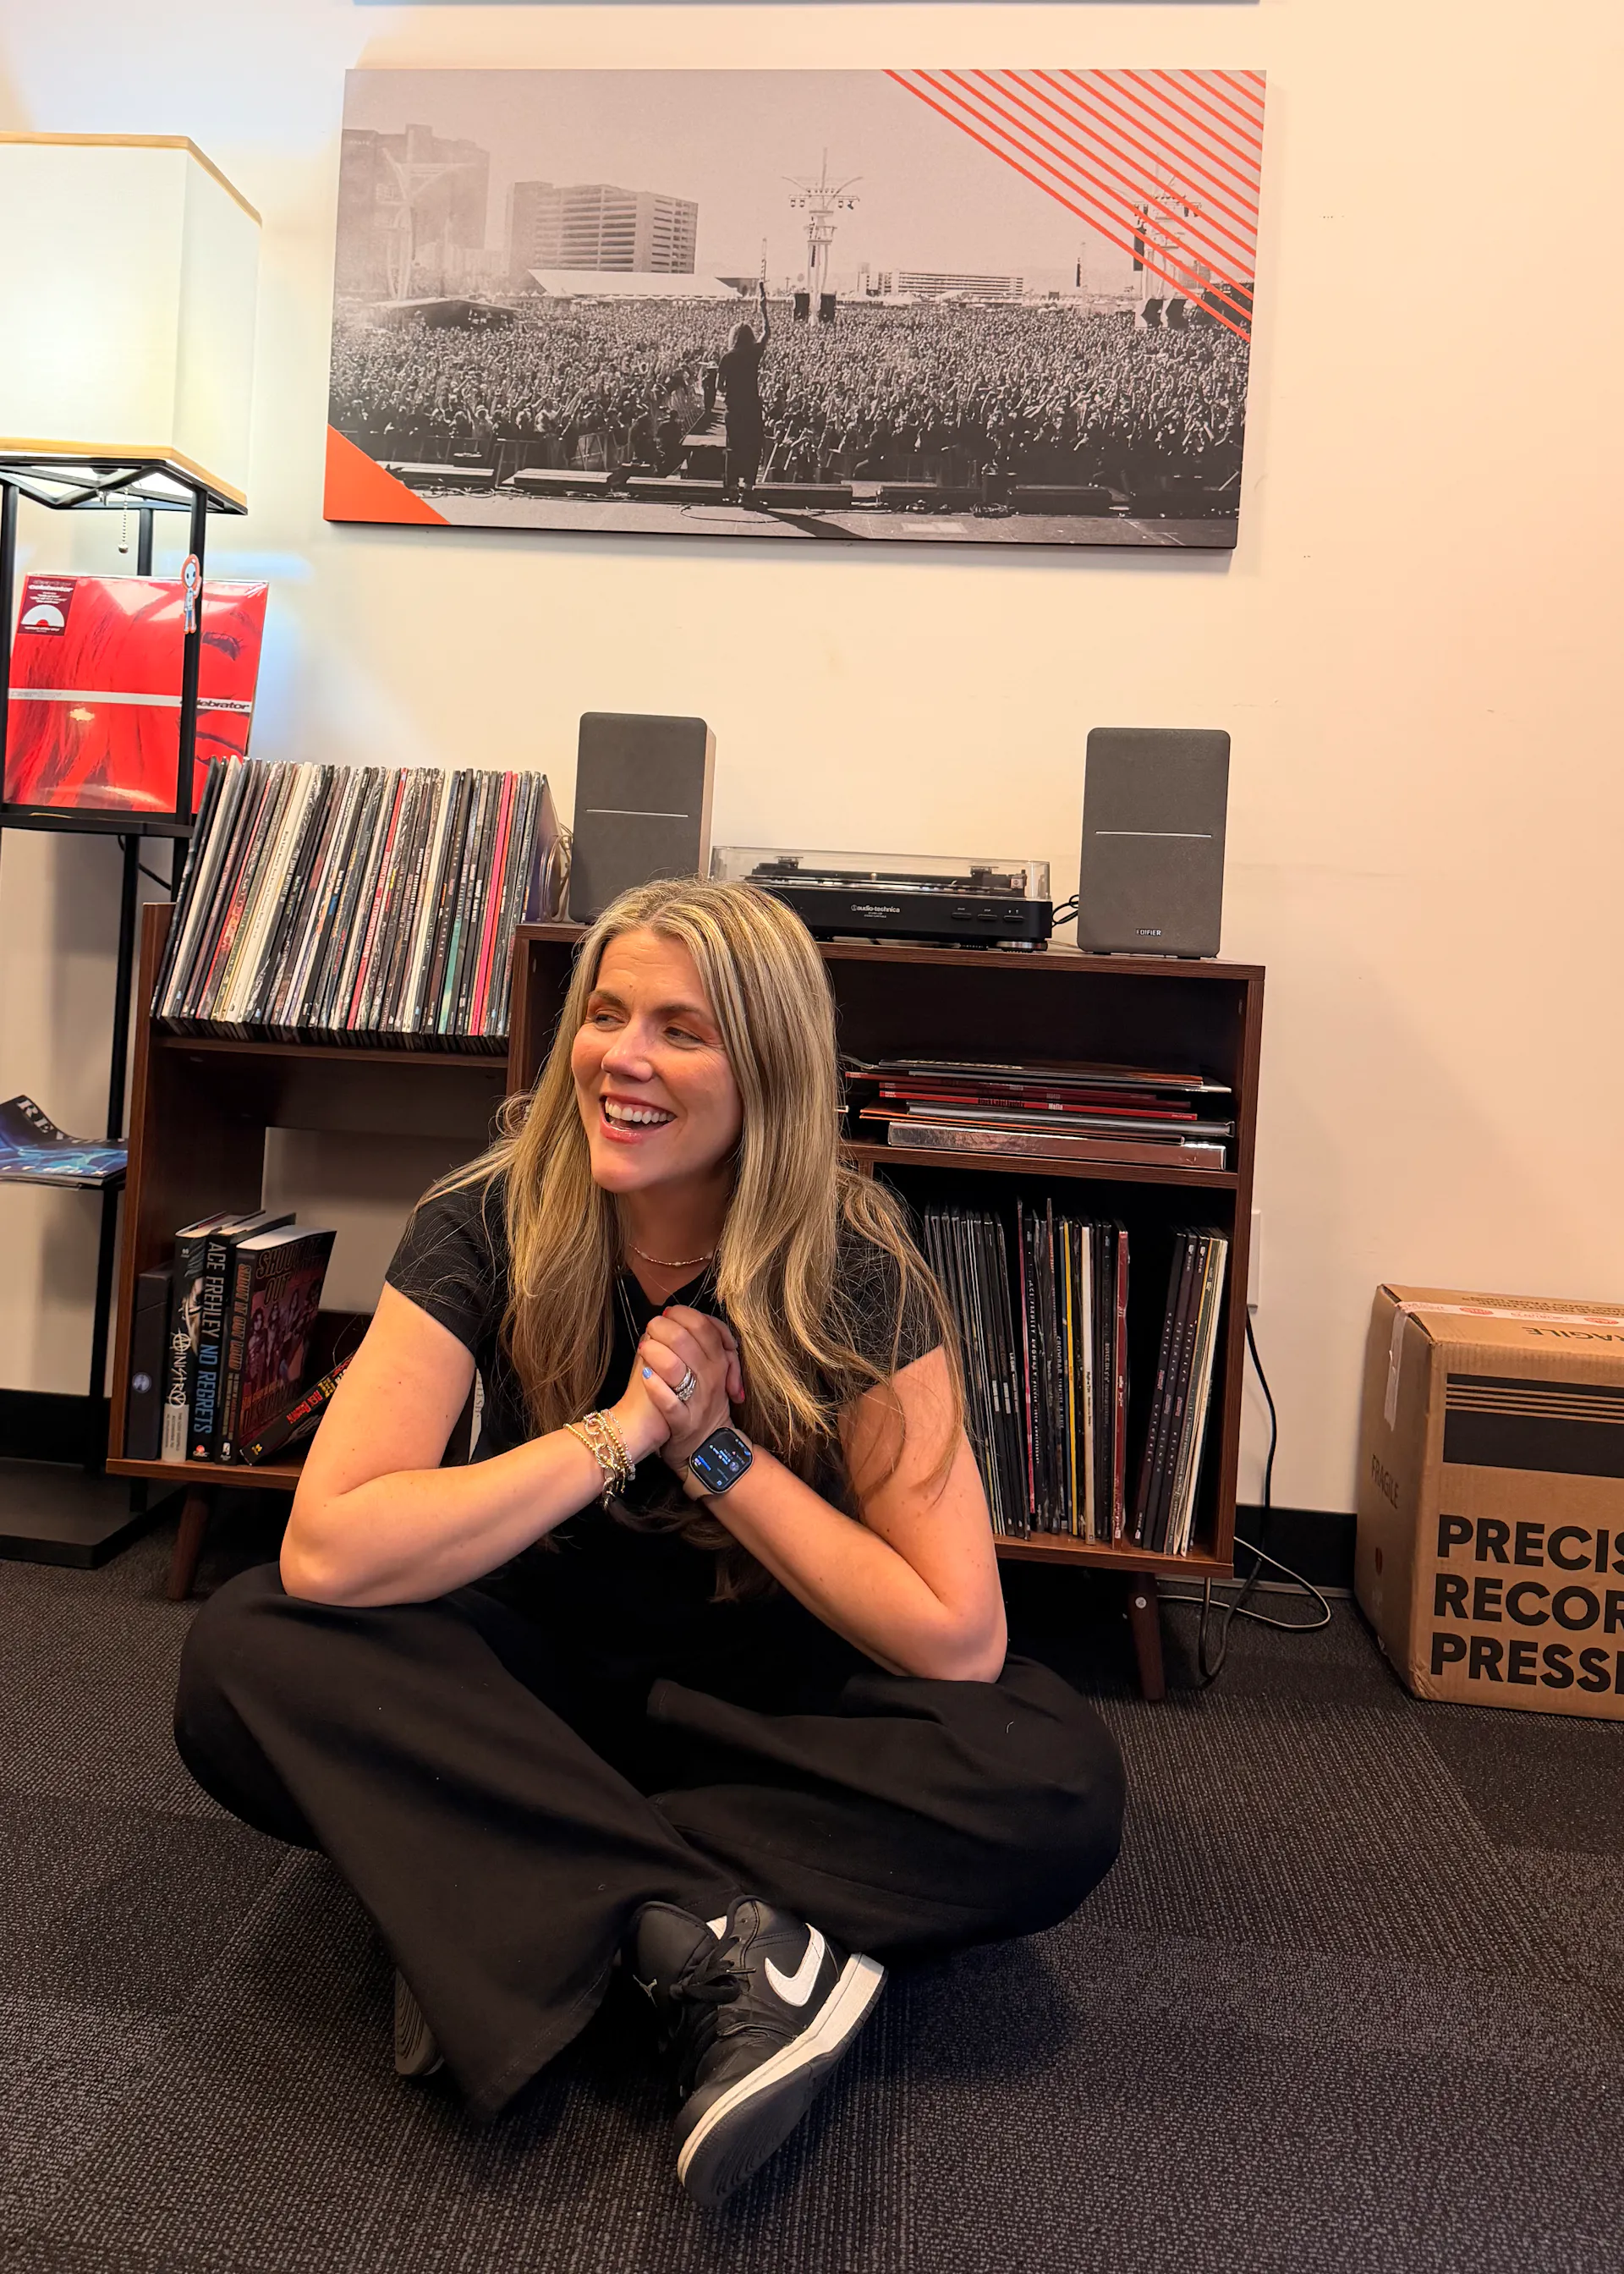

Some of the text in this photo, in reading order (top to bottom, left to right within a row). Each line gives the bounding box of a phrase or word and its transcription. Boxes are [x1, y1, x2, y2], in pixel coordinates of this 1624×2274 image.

[179, 699, 250, 710] lebrator
[207, 1241, 228, 1272] ACE
[201, 1276, 225, 1339] FREHLEY
[167, 1326, 191, 1409] MINISTRY
[197, 1343, 219, 1365] NO
[193, 1370, 217, 1435] REGRETS
[1371, 1454, 1400, 1509] FRAGILE
